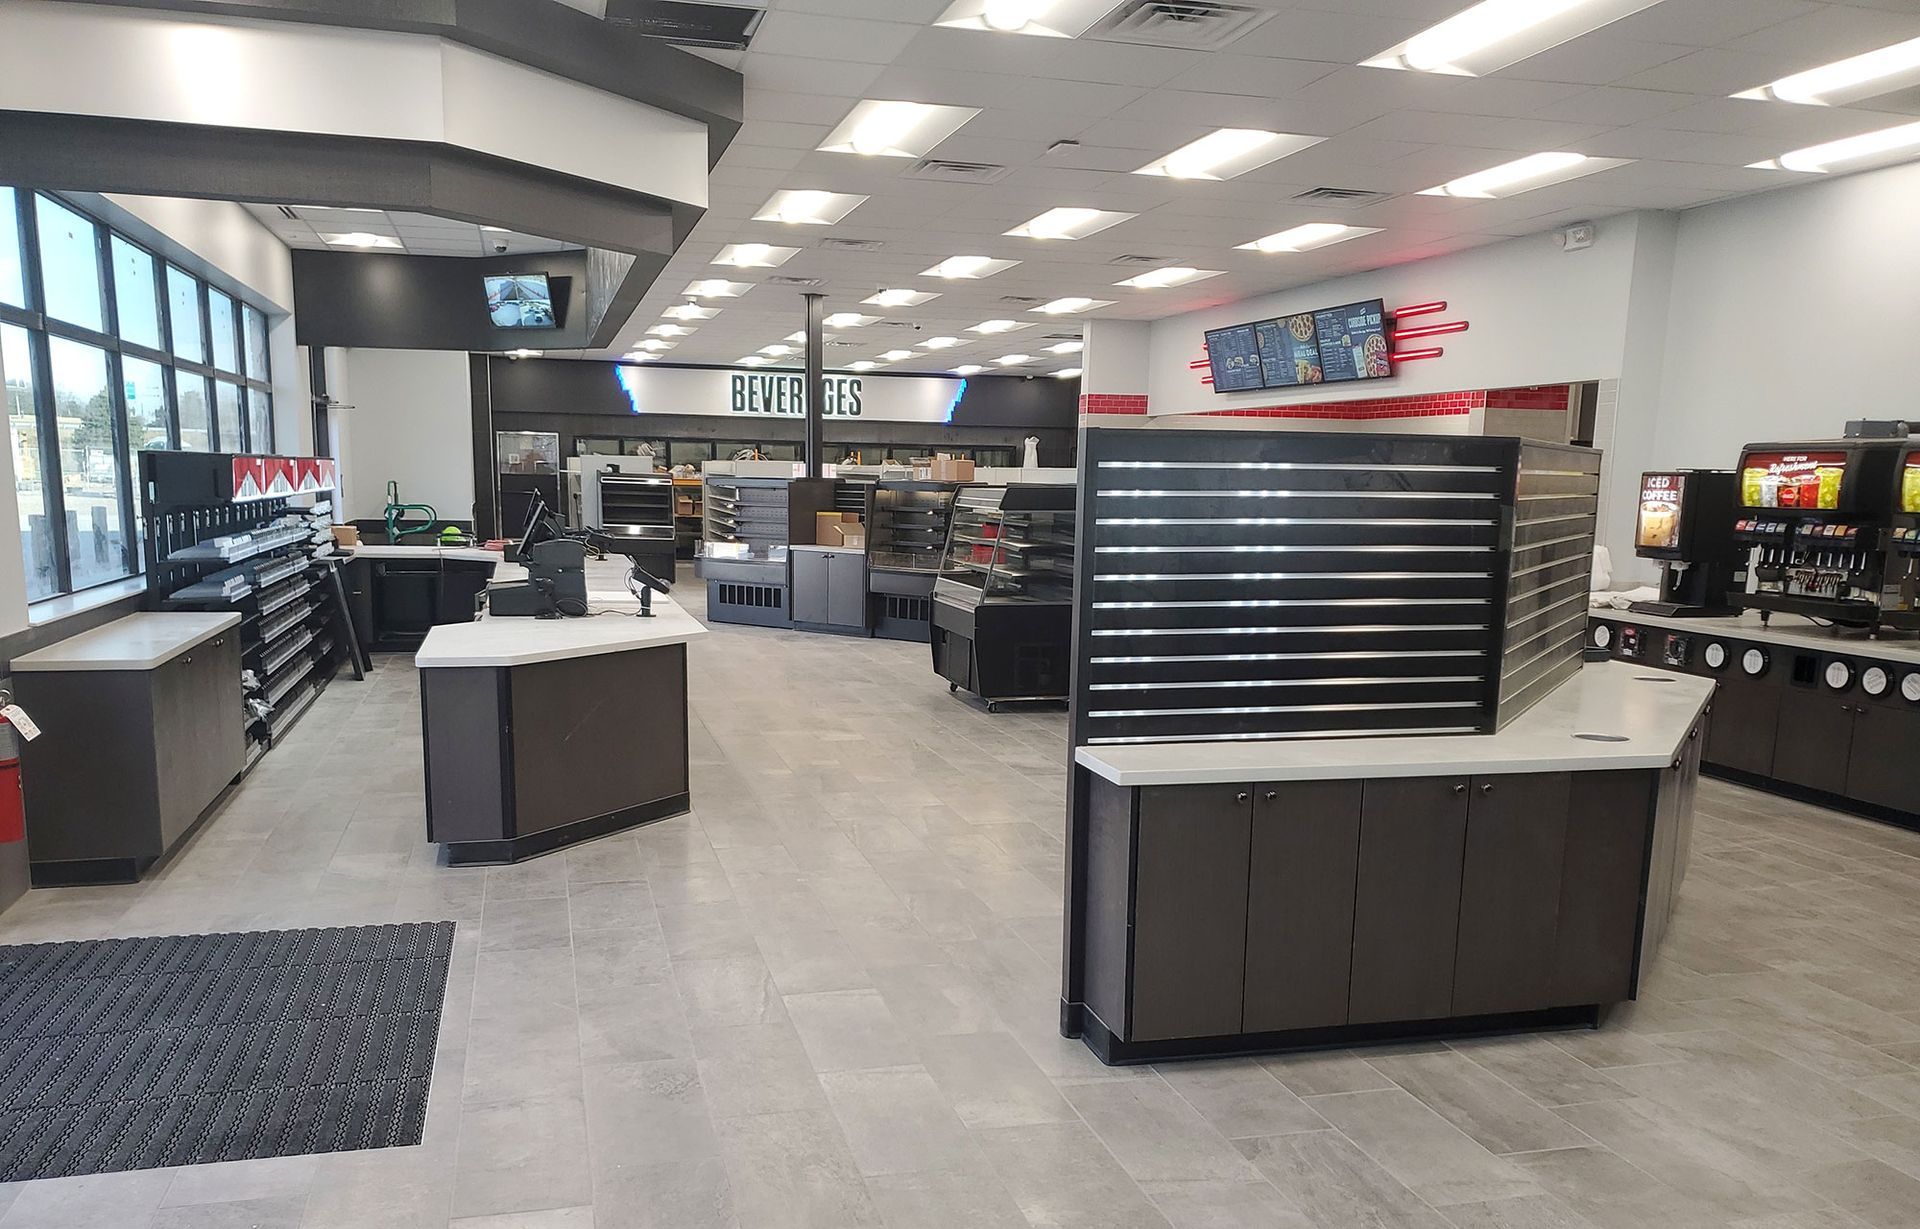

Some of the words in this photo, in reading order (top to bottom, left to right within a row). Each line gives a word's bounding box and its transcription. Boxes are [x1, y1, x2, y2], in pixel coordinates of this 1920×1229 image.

[731, 374, 862, 416] BEVERGES
[1647, 477, 1670, 489] ICED
[1642, 489, 1678, 501] COFFEE
